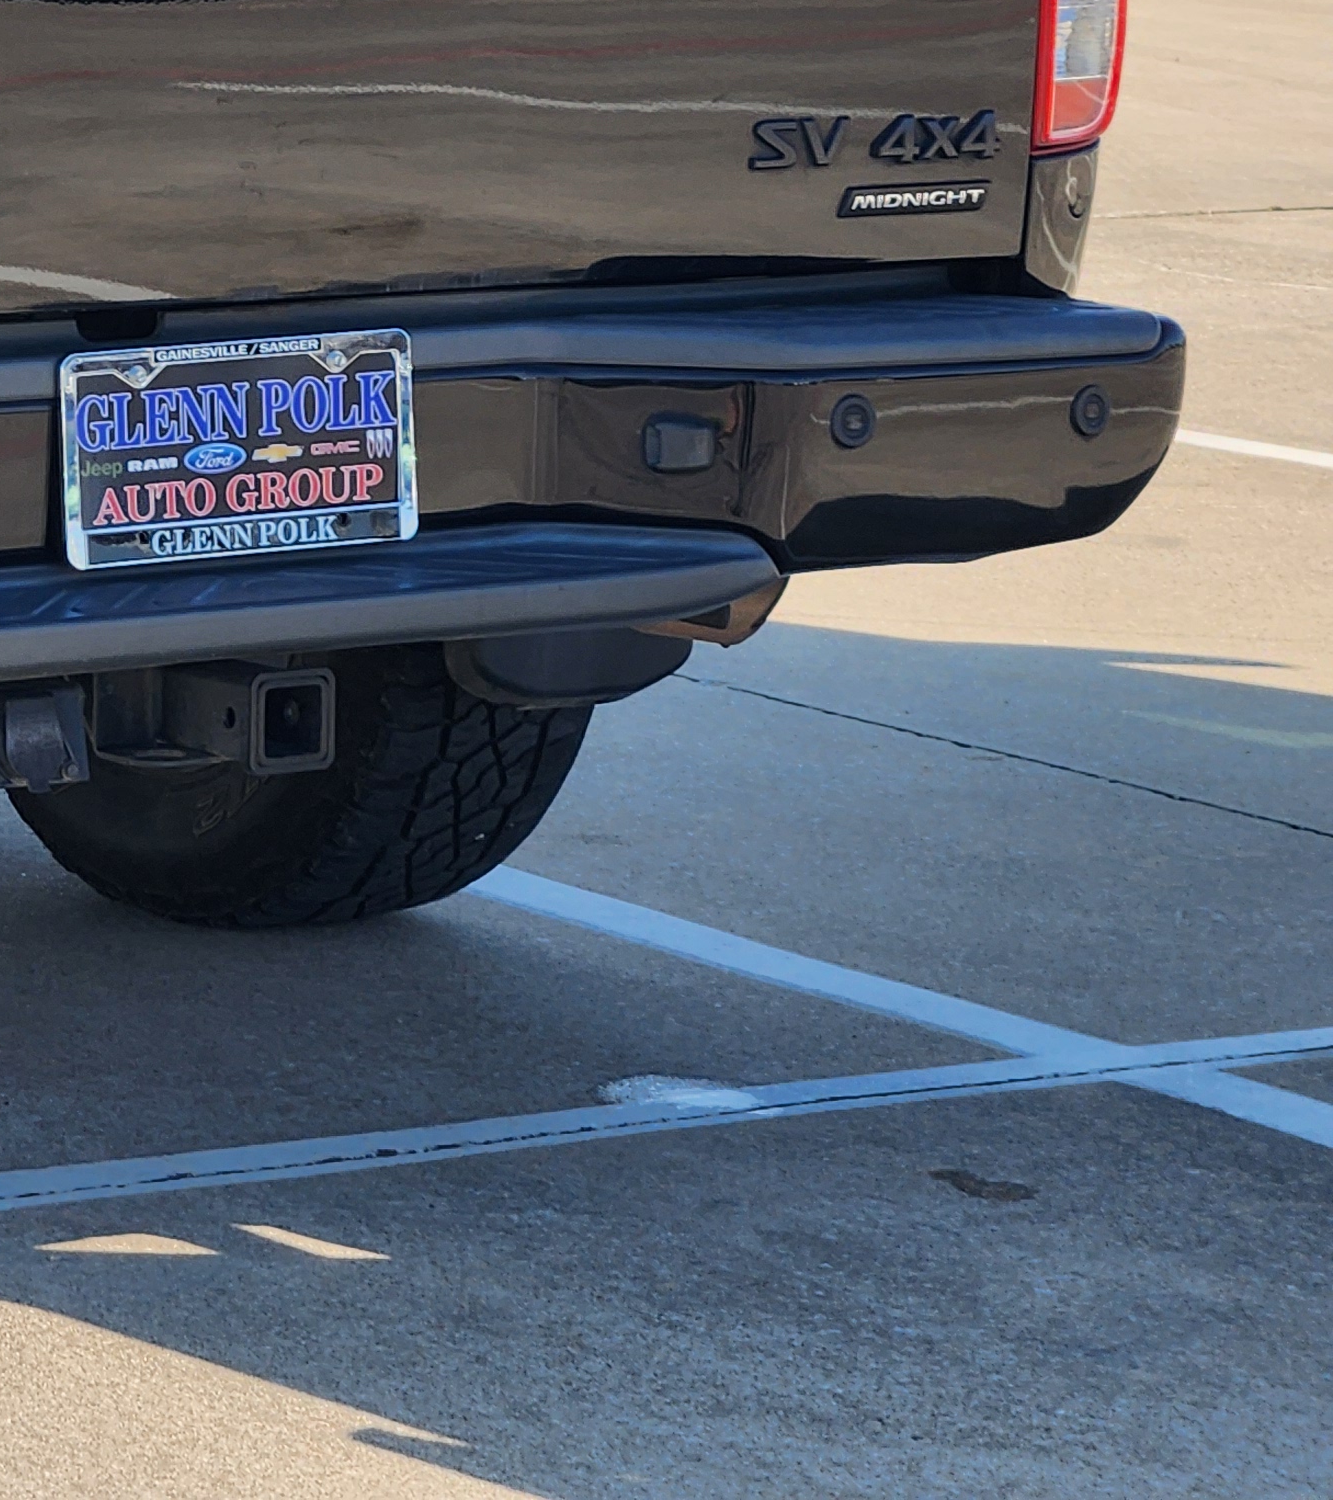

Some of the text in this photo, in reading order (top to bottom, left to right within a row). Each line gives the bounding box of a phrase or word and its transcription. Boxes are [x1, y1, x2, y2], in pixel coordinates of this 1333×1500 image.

[747, 114, 851, 170] SV
[850, 188, 986, 211] MIDNIGHT
[76, 371, 398, 453] GLENN POLK
[80, 440, 361, 479] Jeep RAM Ford GMC
[94, 463, 384, 526] AUTO GROUP
[150, 514, 339, 558] GLENN POLK
